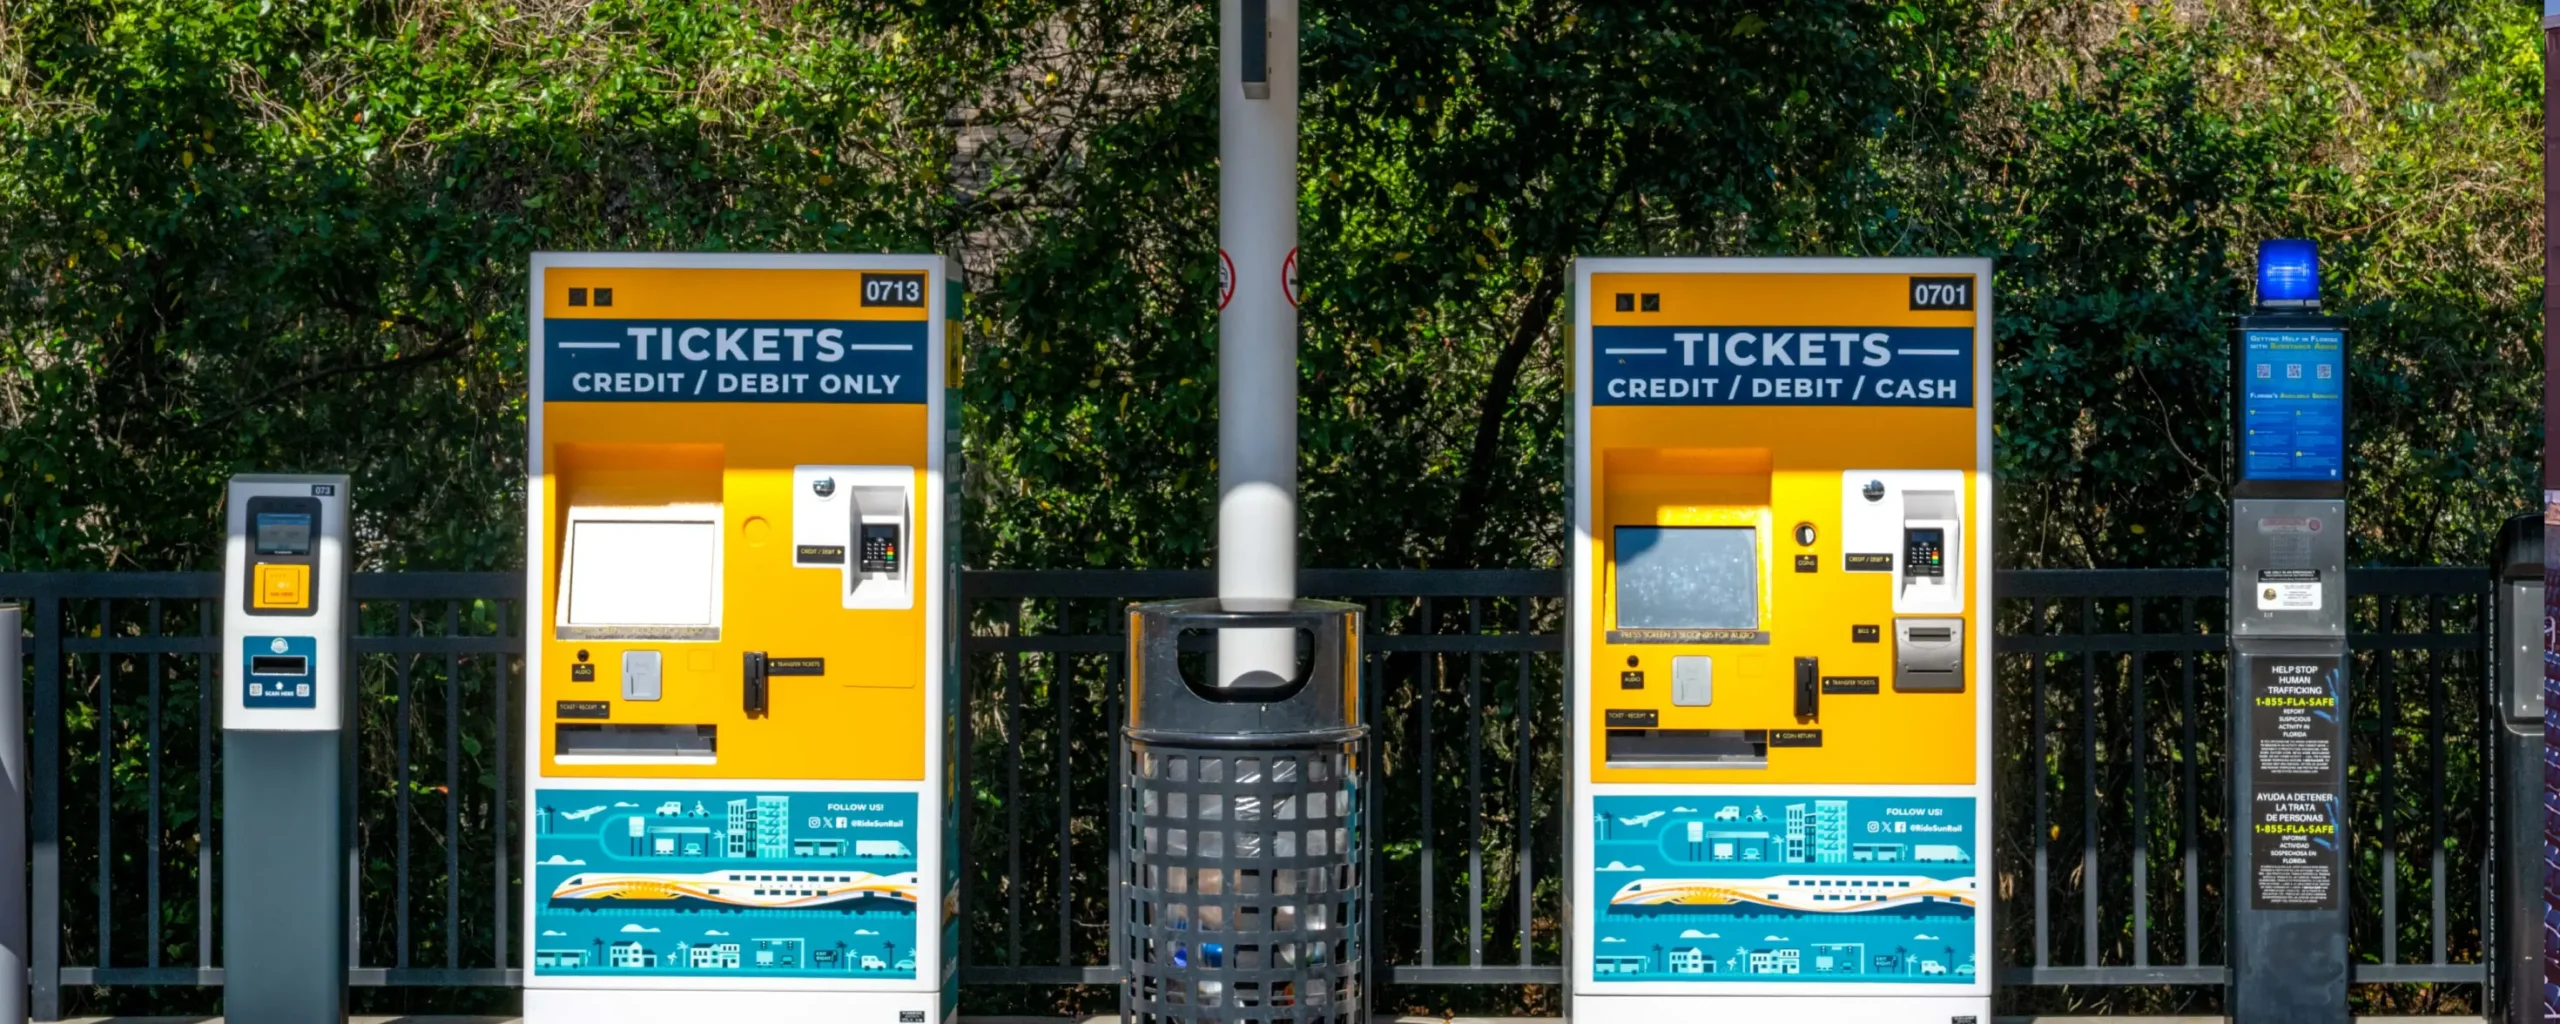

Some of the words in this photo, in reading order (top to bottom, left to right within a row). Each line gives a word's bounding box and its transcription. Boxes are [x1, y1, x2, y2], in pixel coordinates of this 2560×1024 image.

[866, 281, 919, 301] 0713
[1915, 284, 1966, 305] 0701
[627, 327, 845, 362] TICKETS
[1673, 333, 1891, 367] TICKETS
[572, 372, 684, 393] CREDIT
[694, 370, 707, 395] /
[718, 373, 809, 393] DEBIT
[820, 374, 900, 395] ONLY
[1607, 377, 1719, 398] CREDIT
[1728, 376, 1742, 400] /
[1752, 378, 1843, 398] DEBIT
[1852, 376, 1866, 400] /
[1875, 379, 1957, 400] CASH
[315, 486, 331, 495] 073
[1621, 631, 1641, 639] PRESS
[1644, 631, 1670, 639] SCREEN
[1679, 631, 1713, 639] SECONDS
[1715, 631, 1729, 639] FOR
[1731, 631, 1755, 639] AUDIO
[2272, 665, 2294, 674] HELP
[2295, 665, 2318, 674] STOP
[2279, 675, 2311, 684] HUMAN
[2268, 686, 2322, 695] TRAFFICKING
[2255, 697, 2334, 707] 1-855-FLA-SAFE
[2257, 793, 2285, 801] AYUDA
[2287, 793, 2293, 801] A
[2294, 793, 2333, 802] DETENER
[828, 803, 866, 812] FOLLOW
[869, 803, 884, 812] US!
[1886, 807, 1925, 816] FOLLOW
[1927, 807, 1943, 816] US!
[2276, 803, 2287, 812] LA
[2288, 803, 2316, 812] TRATA
[2266, 813, 2278, 822] DE
[2279, 813, 2324, 822] PERSONAS
[850, 820, 904, 829] @RideSunRail
[1909, 823, 1963, 832] @RideSunRail
[2255, 824, 2334, 834] 1-855-FLA-SAFE
